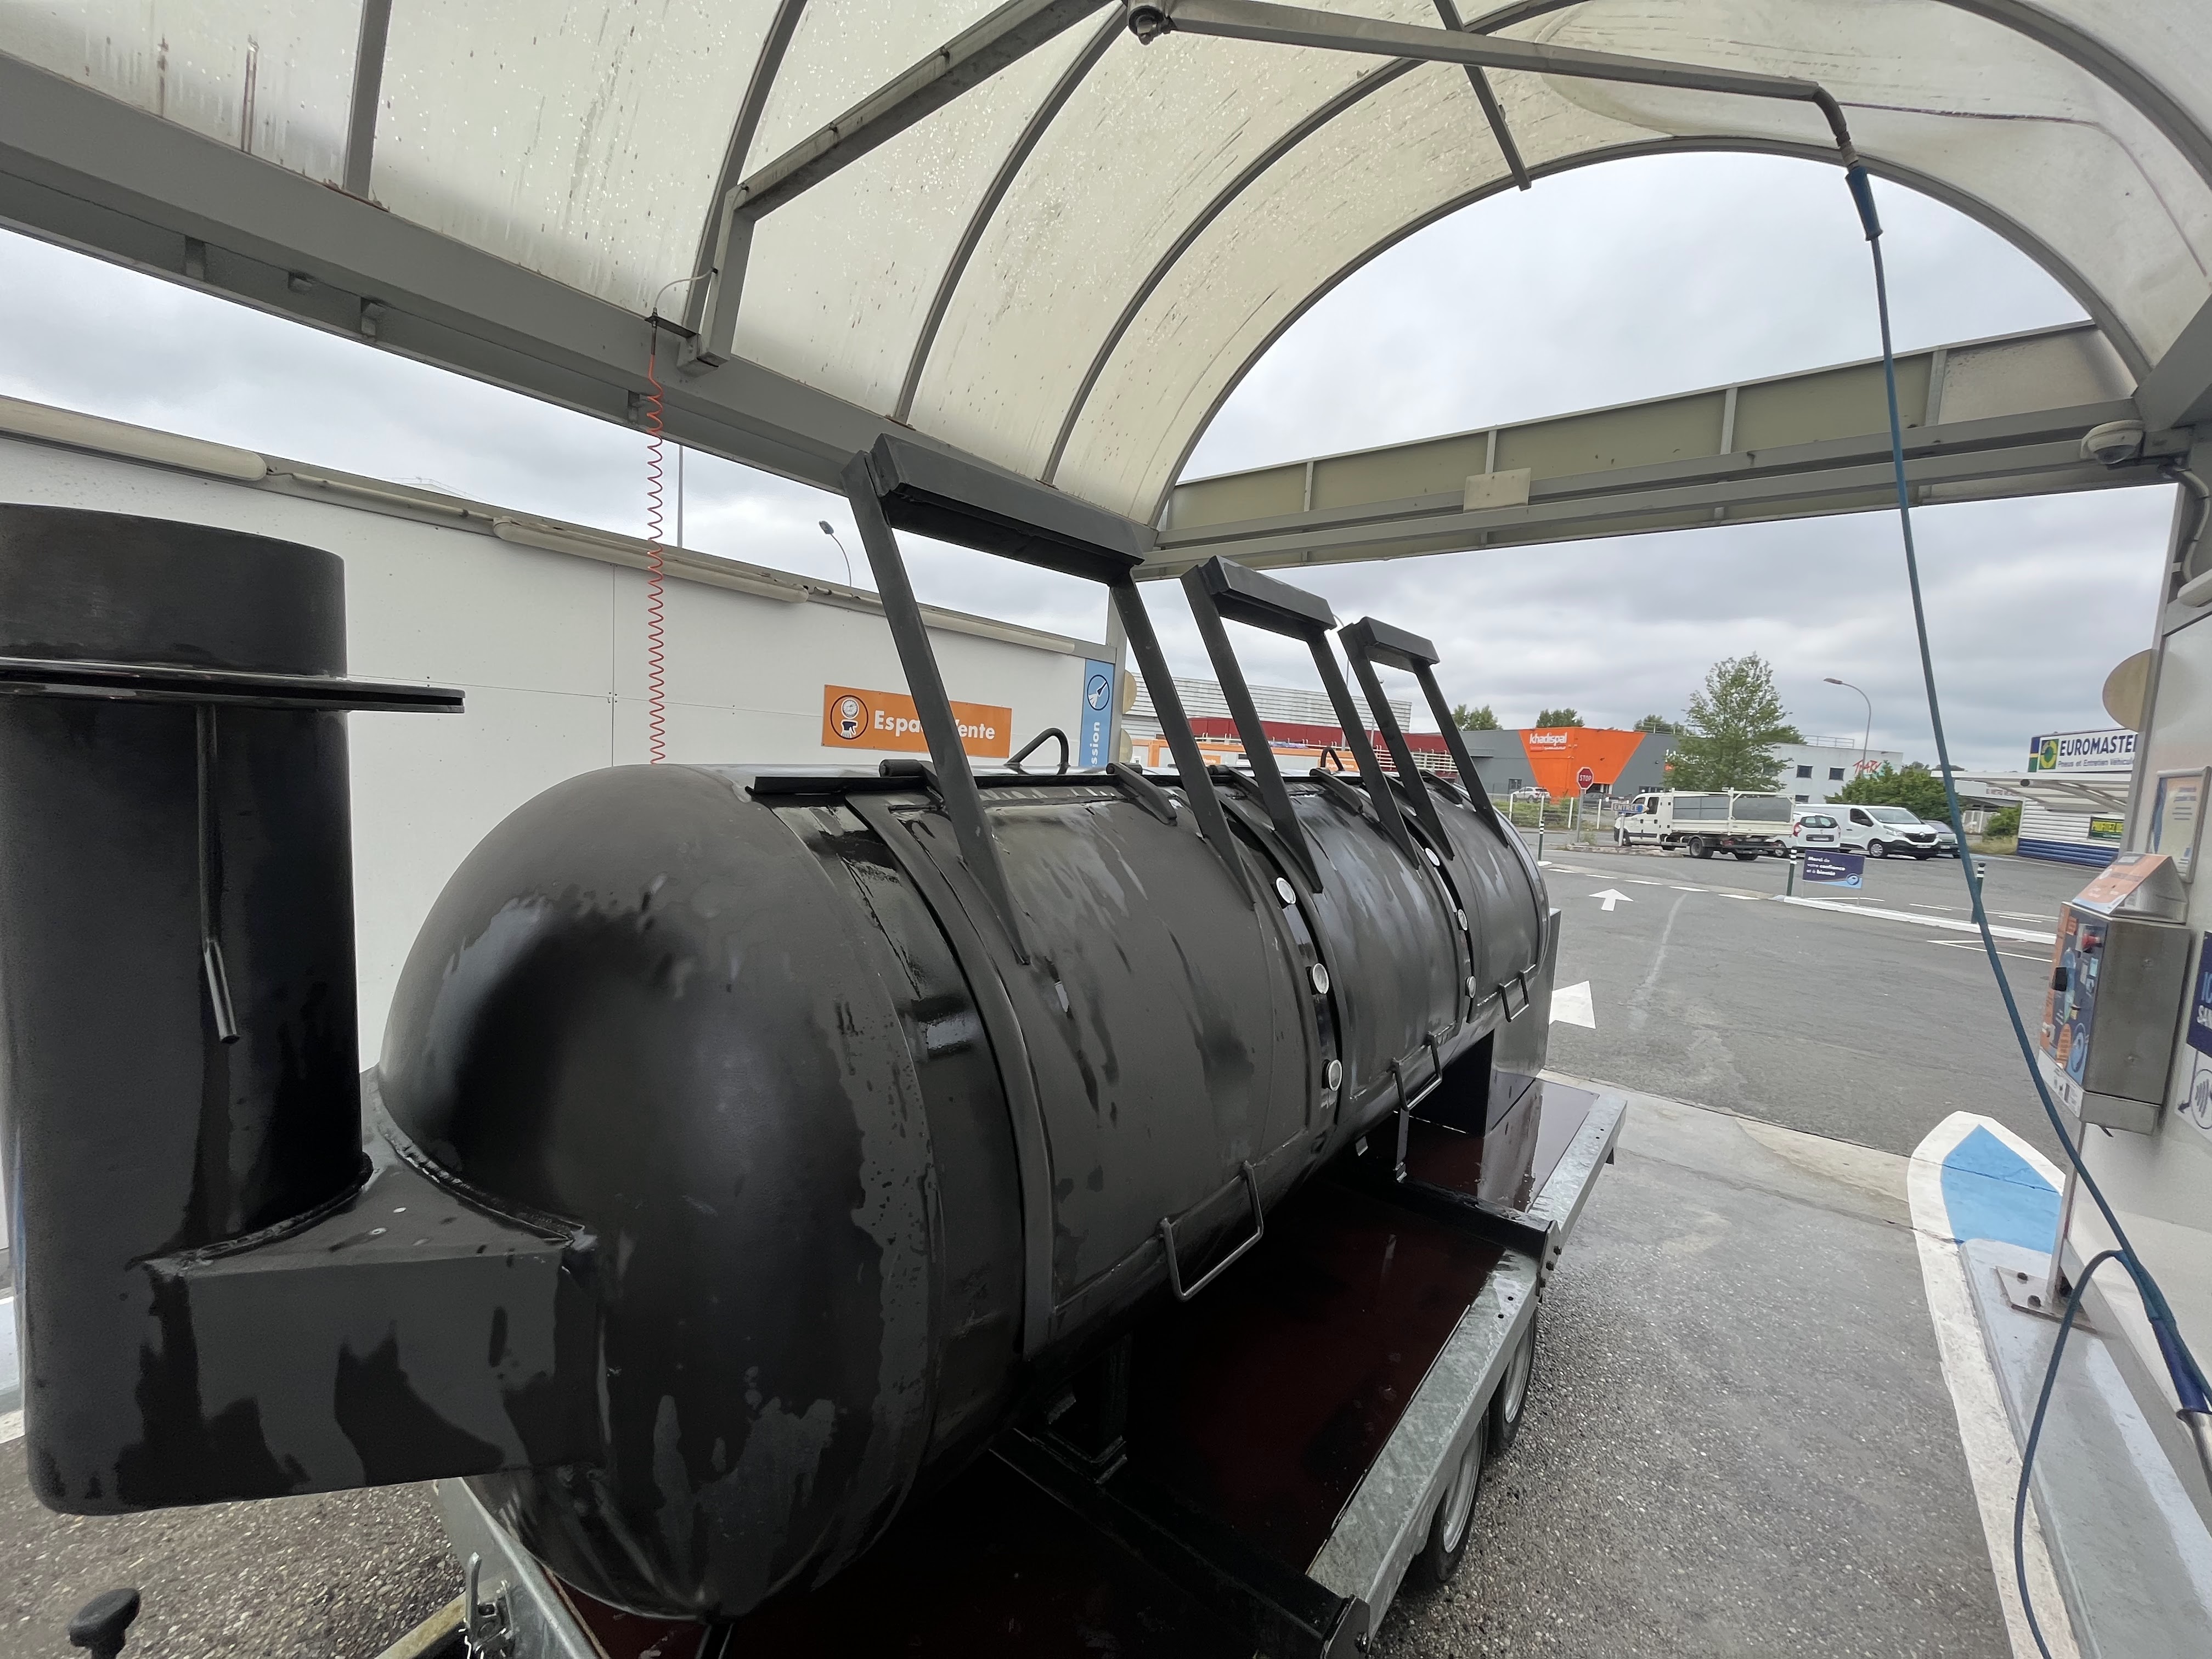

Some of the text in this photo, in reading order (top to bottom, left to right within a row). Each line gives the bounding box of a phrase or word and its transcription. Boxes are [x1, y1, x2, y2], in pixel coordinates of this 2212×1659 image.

[873, 709, 924, 737] Espa
[1089, 721, 1101, 767] ssion
[1529, 731, 1567, 747] khadispal
